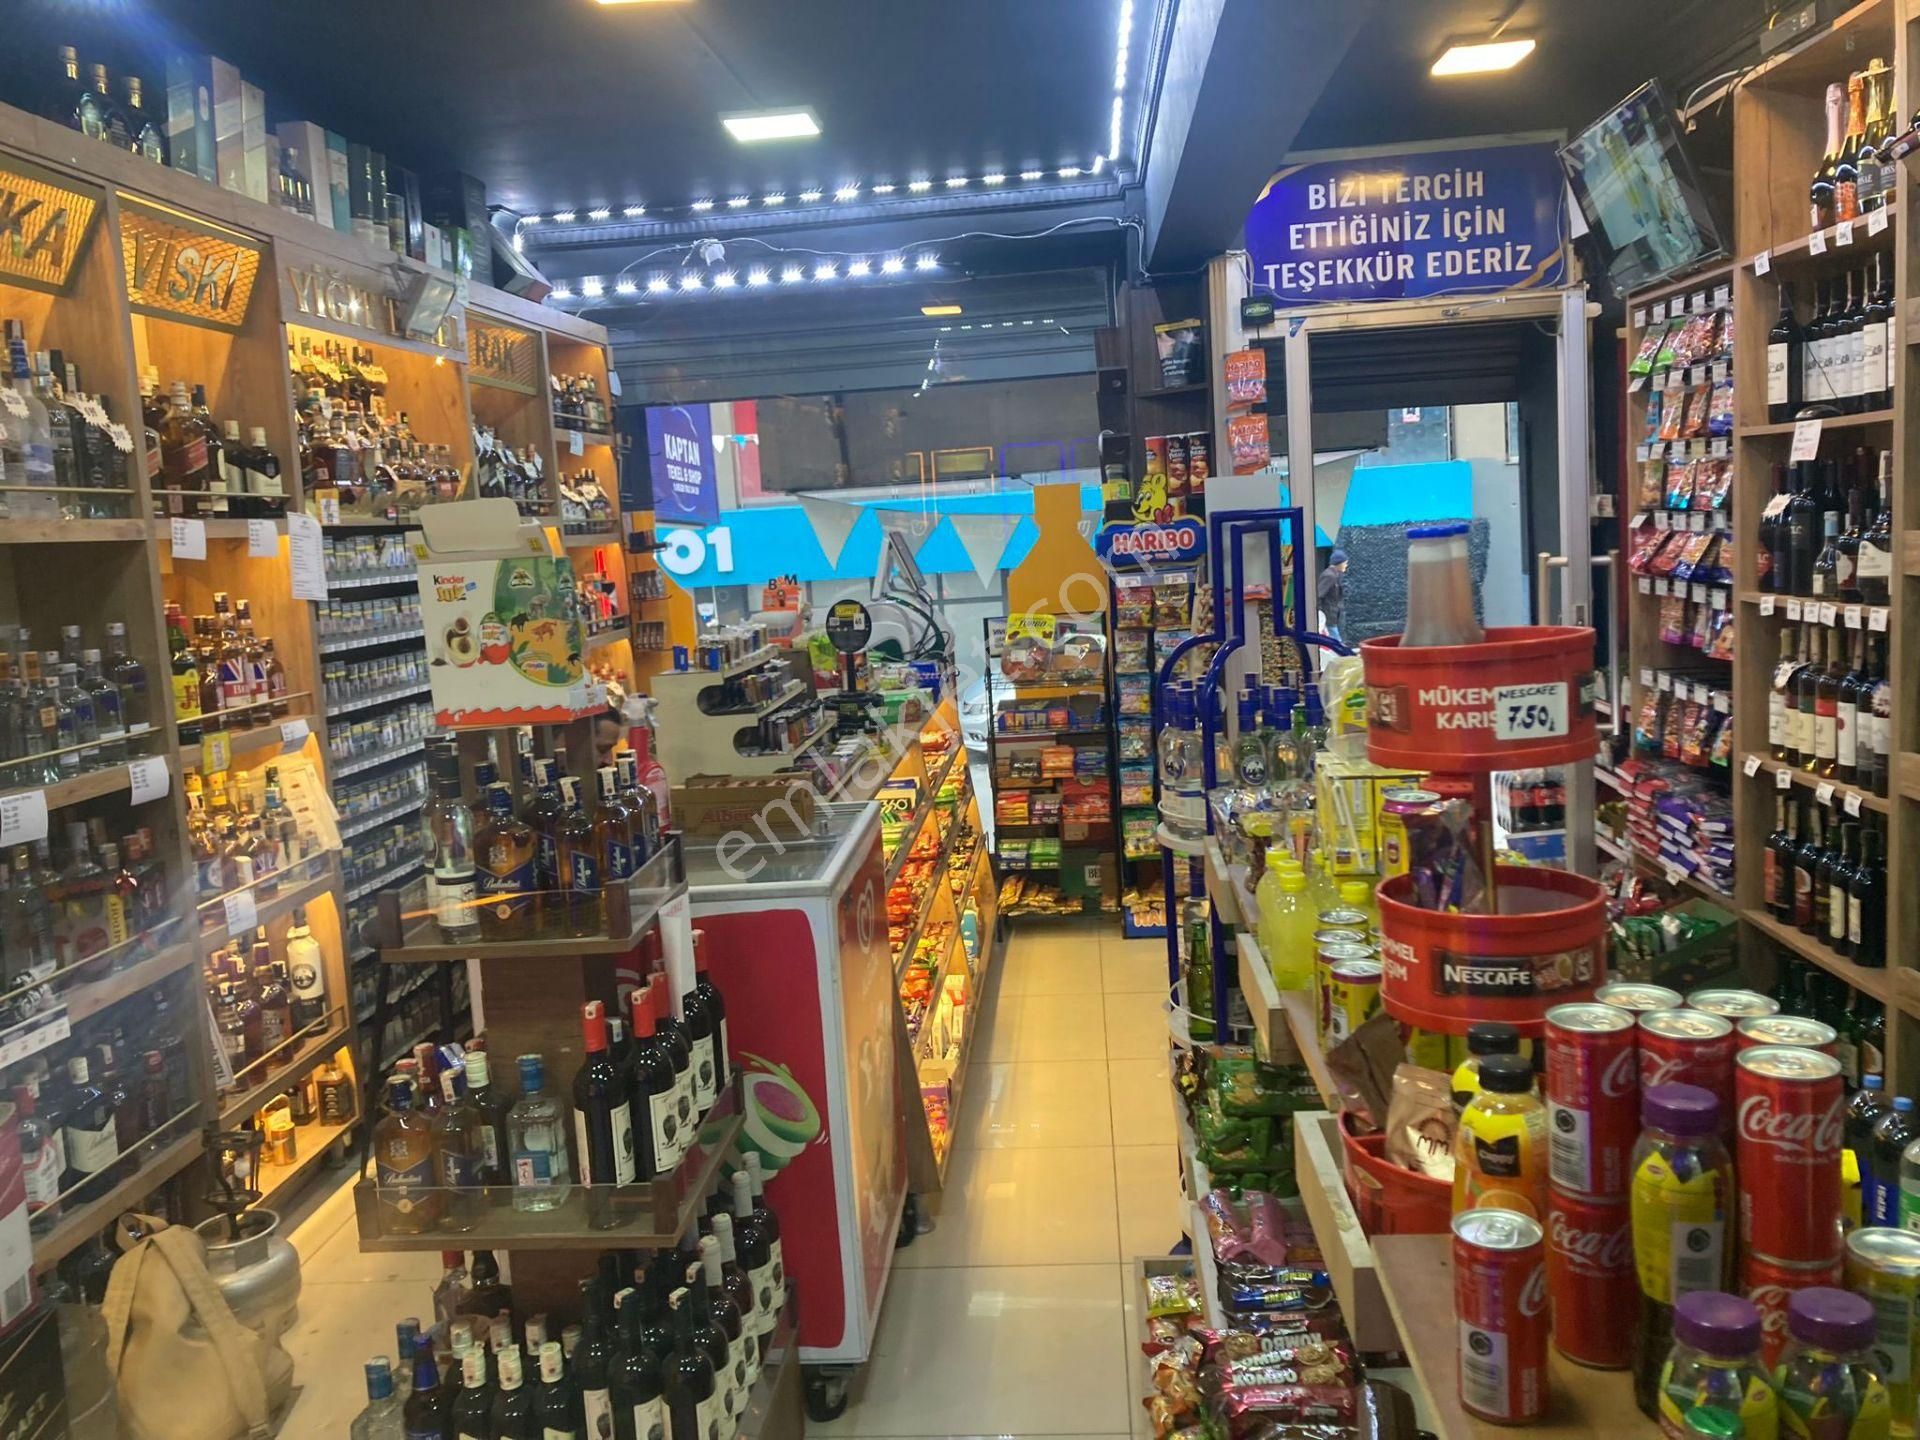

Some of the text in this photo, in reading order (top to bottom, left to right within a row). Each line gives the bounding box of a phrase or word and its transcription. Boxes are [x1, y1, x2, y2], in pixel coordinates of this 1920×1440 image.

[1308, 167, 1484, 211] BİZİ TERCİH
[1289, 207, 1505, 251] ETTİĞİNİZ İÇİN
[1263, 243, 1533, 293] TEŞEKKÜR EDERİZ
[664, 432, 700, 467] KAPTAN
[1112, 527, 1195, 556] HARIBO
[1876, 1184, 1888, 1221] PEPSI
[1232, 1368, 1298, 1387] KOMBO
